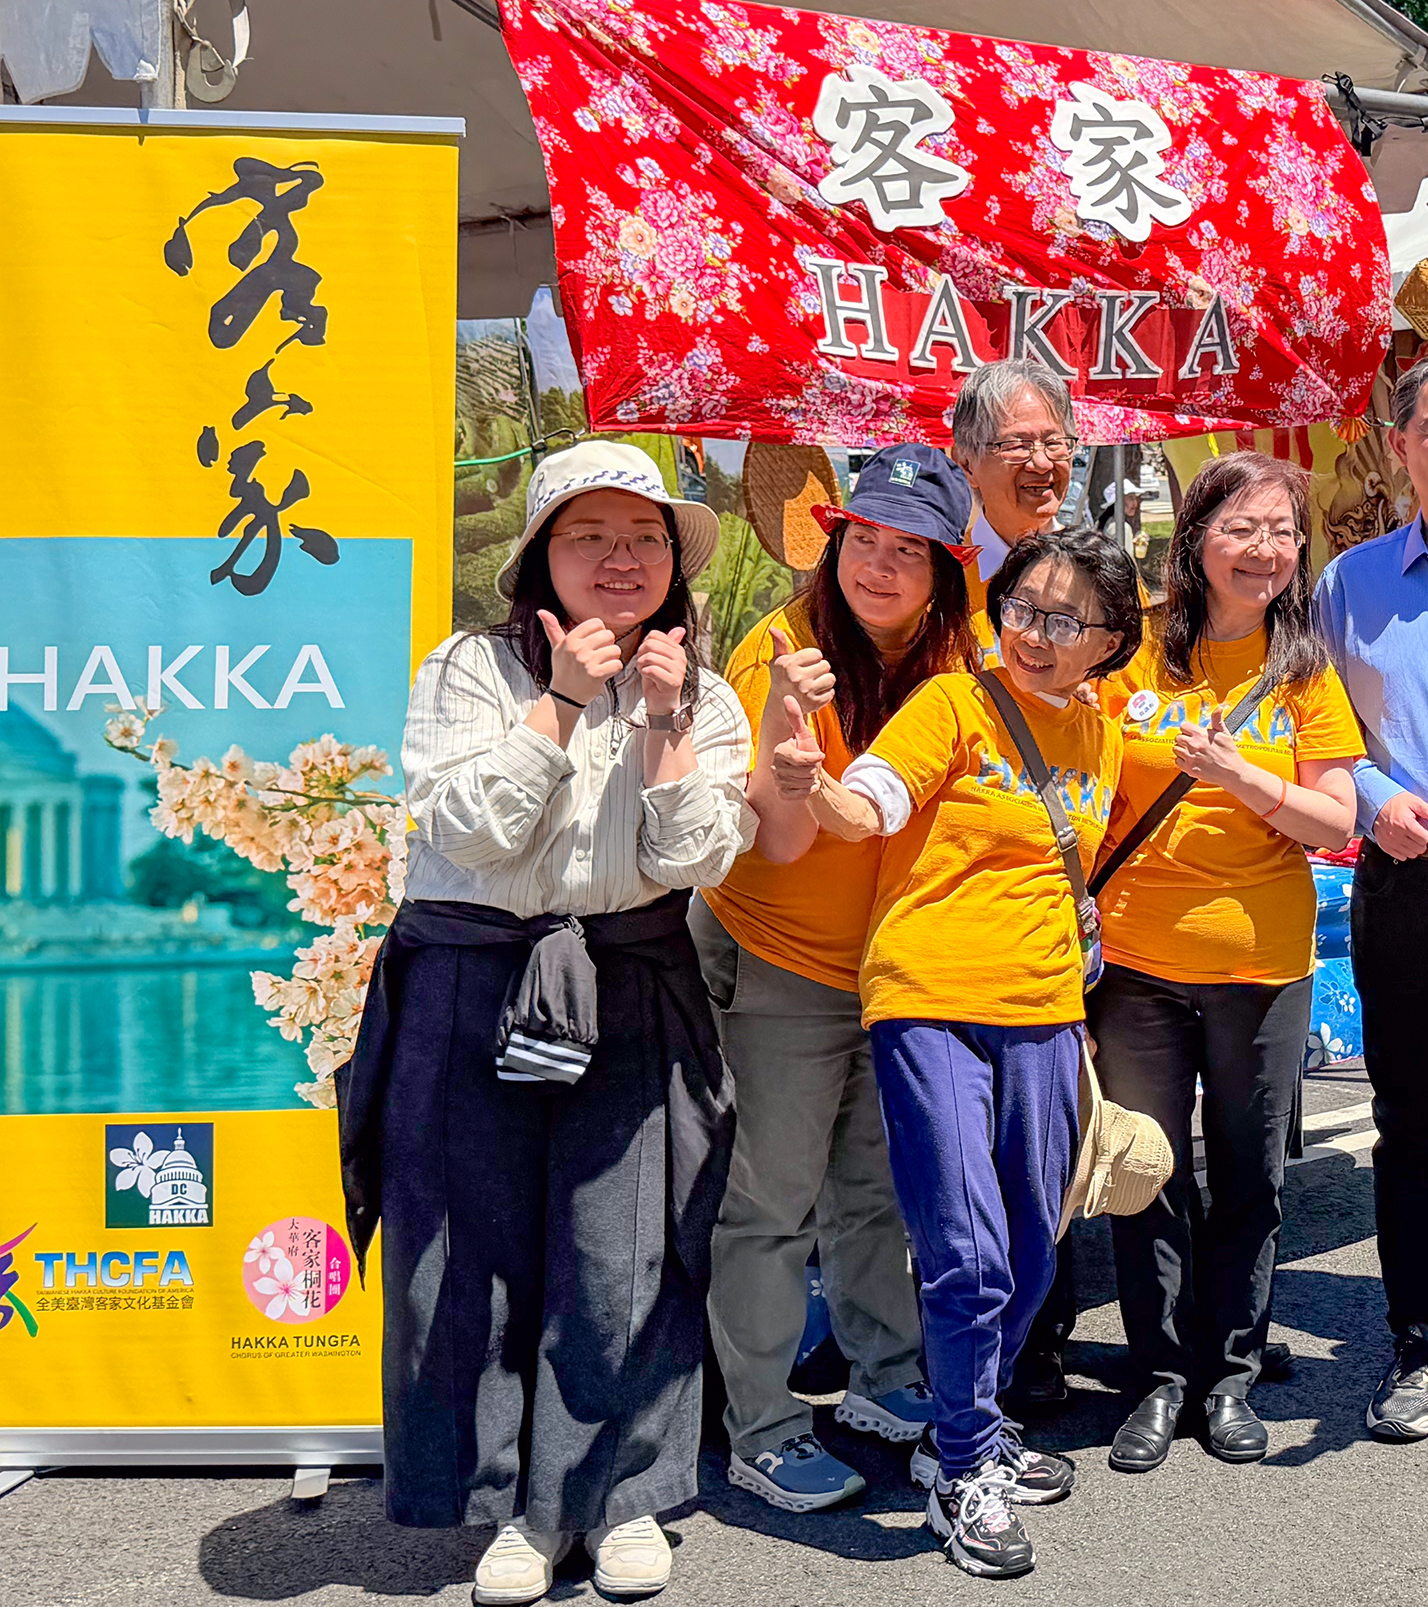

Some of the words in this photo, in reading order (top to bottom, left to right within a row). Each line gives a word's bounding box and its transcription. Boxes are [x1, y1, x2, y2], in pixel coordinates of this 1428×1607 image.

[828, 78, 1187, 232] 客家
[805, 256, 1239, 381] HAKKA
[0, 644, 346, 711] HAKKA
[171, 1183, 187, 1195] DC
[149, 1208, 209, 1225] HAKKA
[34, 1250, 194, 1289] THCFA
[302, 1228, 322, 1309] 客家桐花
[36, 1295, 194, 1312] 全美臺灣客家文化基金會
[231, 1336, 289, 1350] HAKKA
[293, 1334, 360, 1348] TUNGFA
